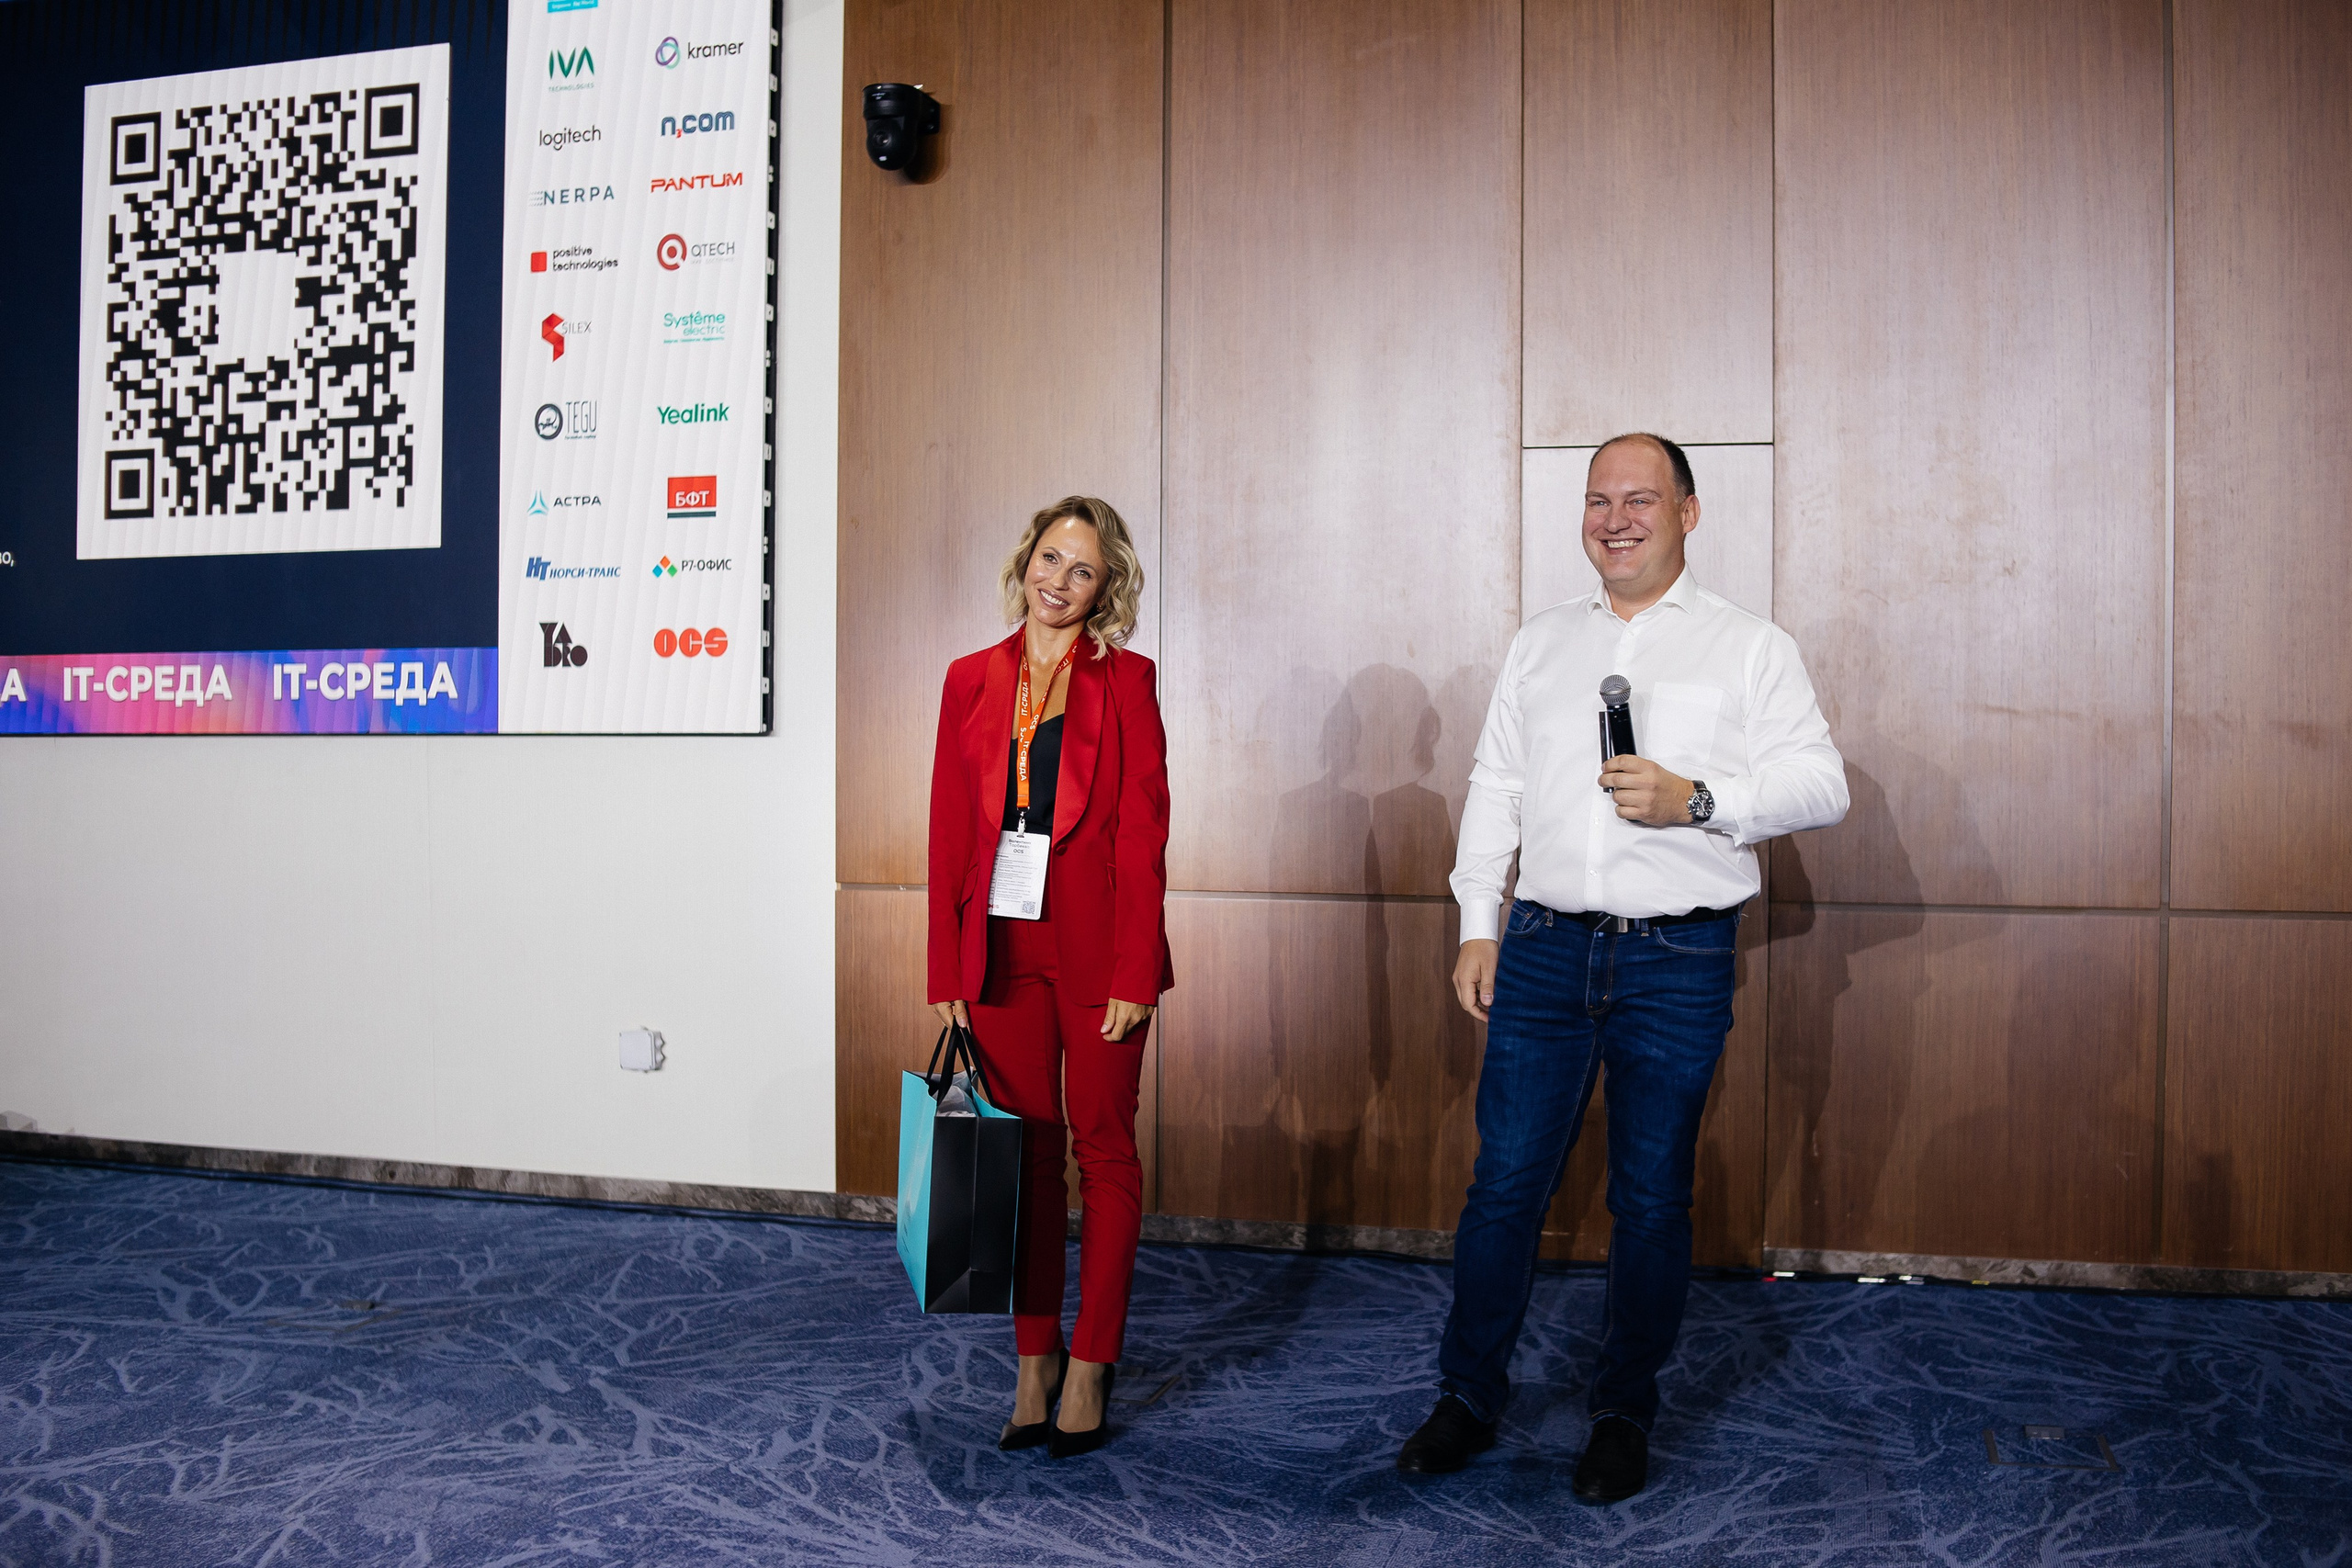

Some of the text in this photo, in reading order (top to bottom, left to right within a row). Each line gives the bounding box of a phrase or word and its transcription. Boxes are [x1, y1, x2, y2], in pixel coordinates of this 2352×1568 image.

[687, 41, 744, 60] kramer
[548, 46, 595, 80] IVA
[538, 124, 602, 152] logitech
[650, 172, 743, 193] PANTUM
[543, 185, 615, 206] NERPA
[552, 245, 593, 260] positive
[691, 242, 736, 258] QTECH
[552, 256, 619, 272] technologies
[683, 325, 726, 336] electric
[565, 400, 597, 434] TEGU
[657, 402, 730, 425] Yealink
[553, 495, 602, 507] АСТРА
[675, 491, 710, 507] БФТ
[548, 566, 621, 580] НОРСИ-ТРАНС
[681, 558, 732, 571] Р7-ОФИС
[653, 626, 729, 659] OCS
[63, 664, 233, 707] IT-СРЕДА
[273, 661, 459, 706] IT-СРЕДА
[1029, 714, 1040, 730] OCS
